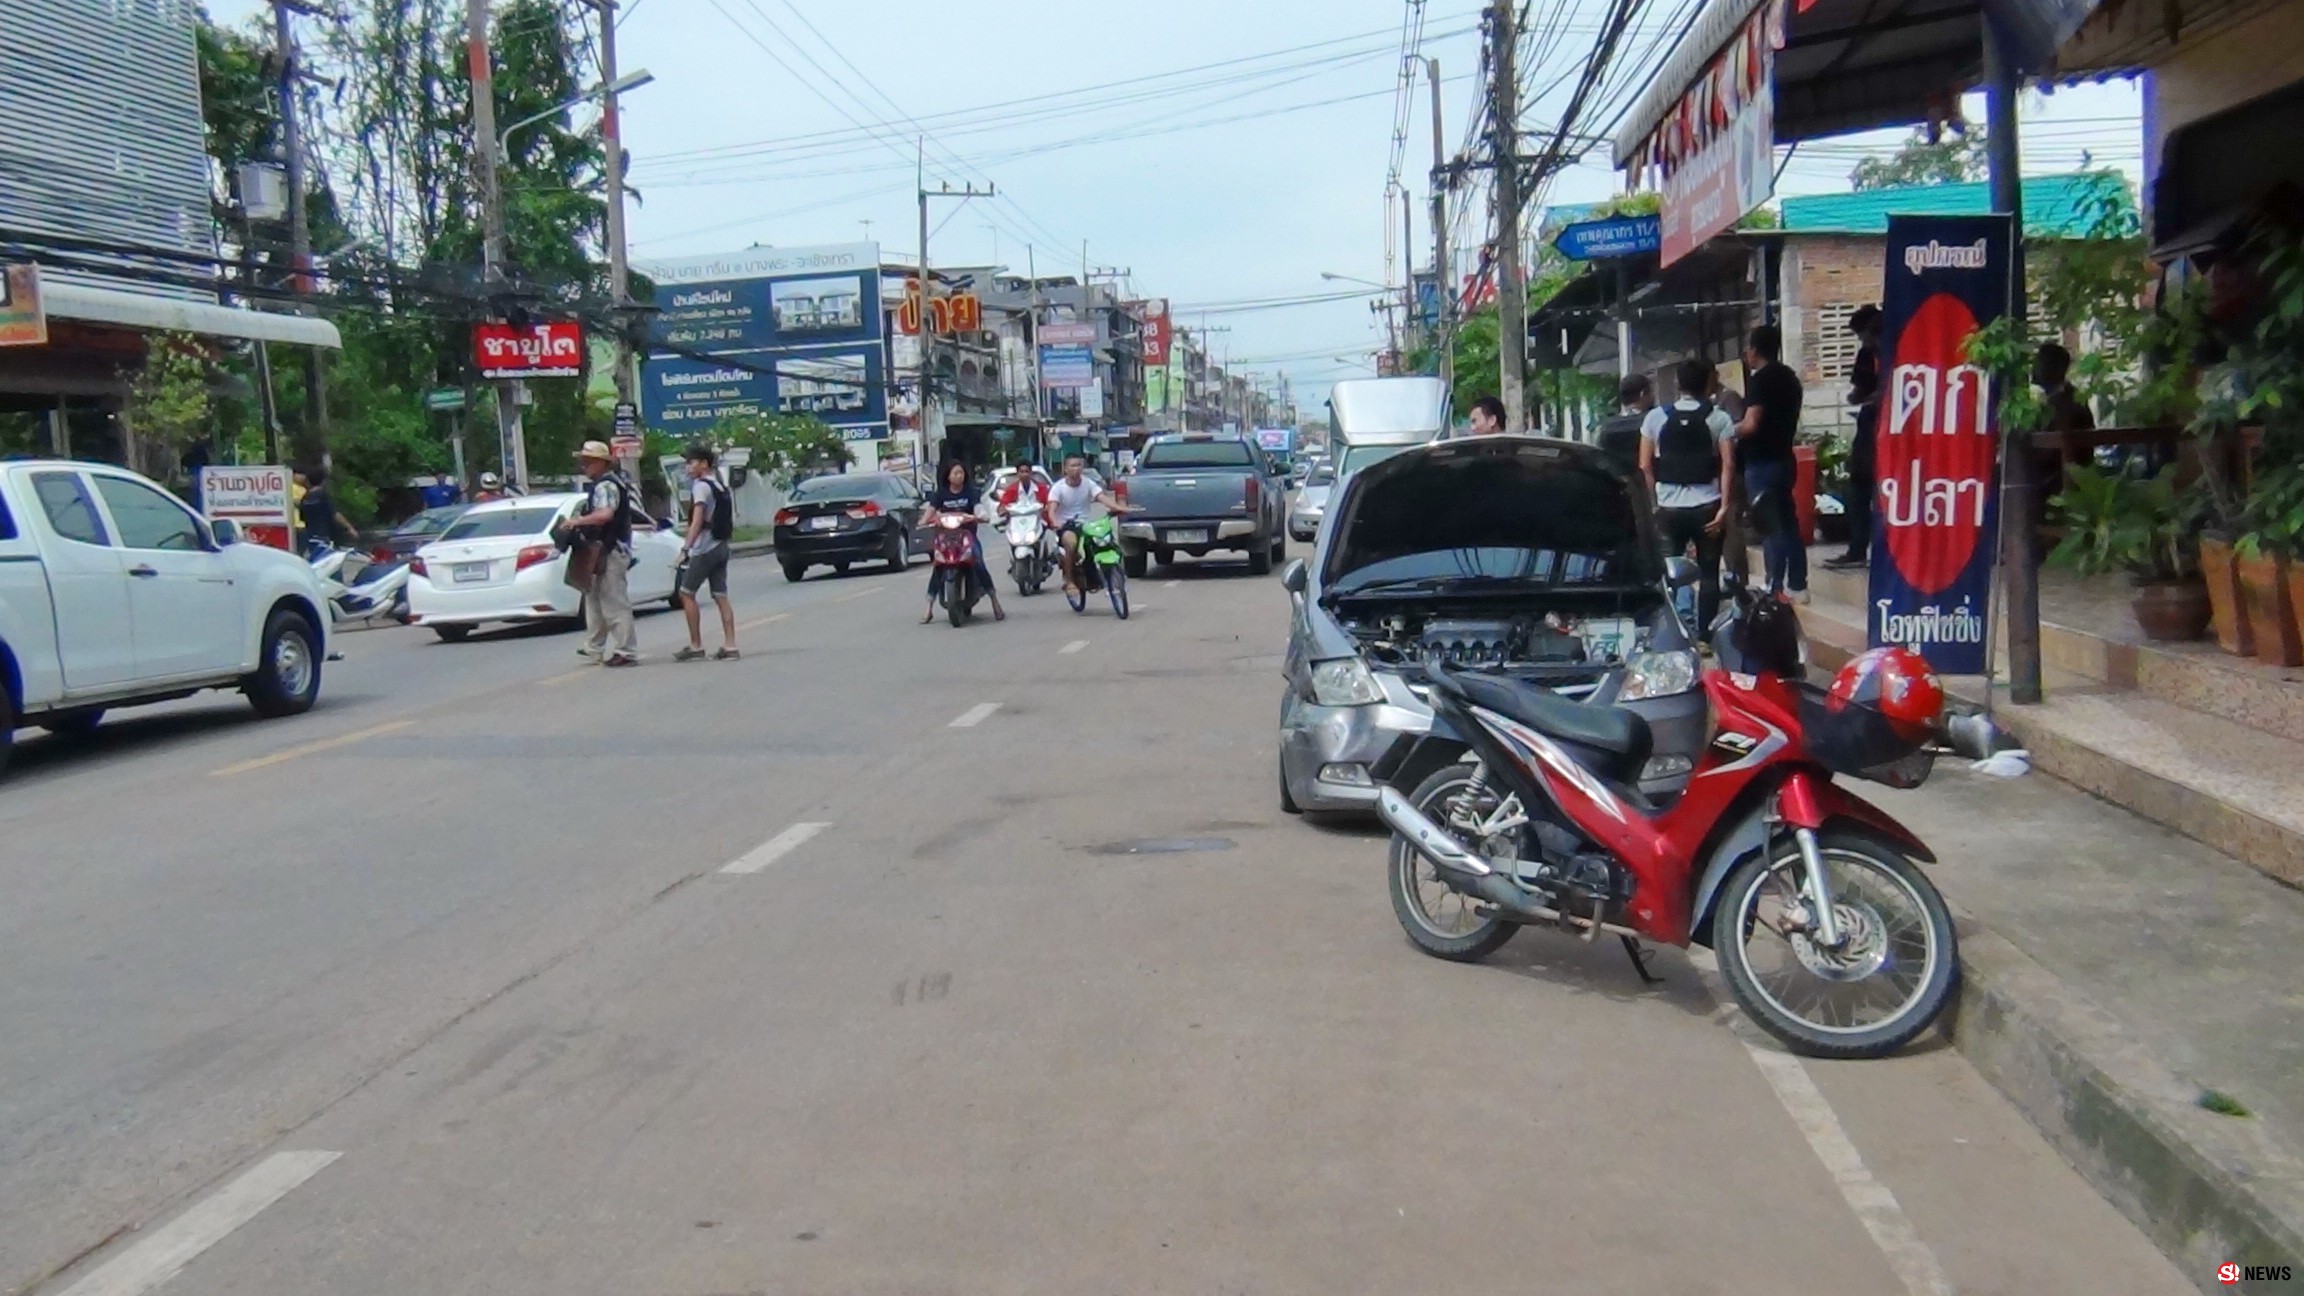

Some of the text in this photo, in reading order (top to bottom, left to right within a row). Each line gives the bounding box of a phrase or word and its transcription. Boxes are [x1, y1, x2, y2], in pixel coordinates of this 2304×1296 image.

[1904, 238, 1987, 275] อุปกรณ์
[1889, 363, 1990, 435] ตก
[1881, 458, 1984, 527] ปลา
